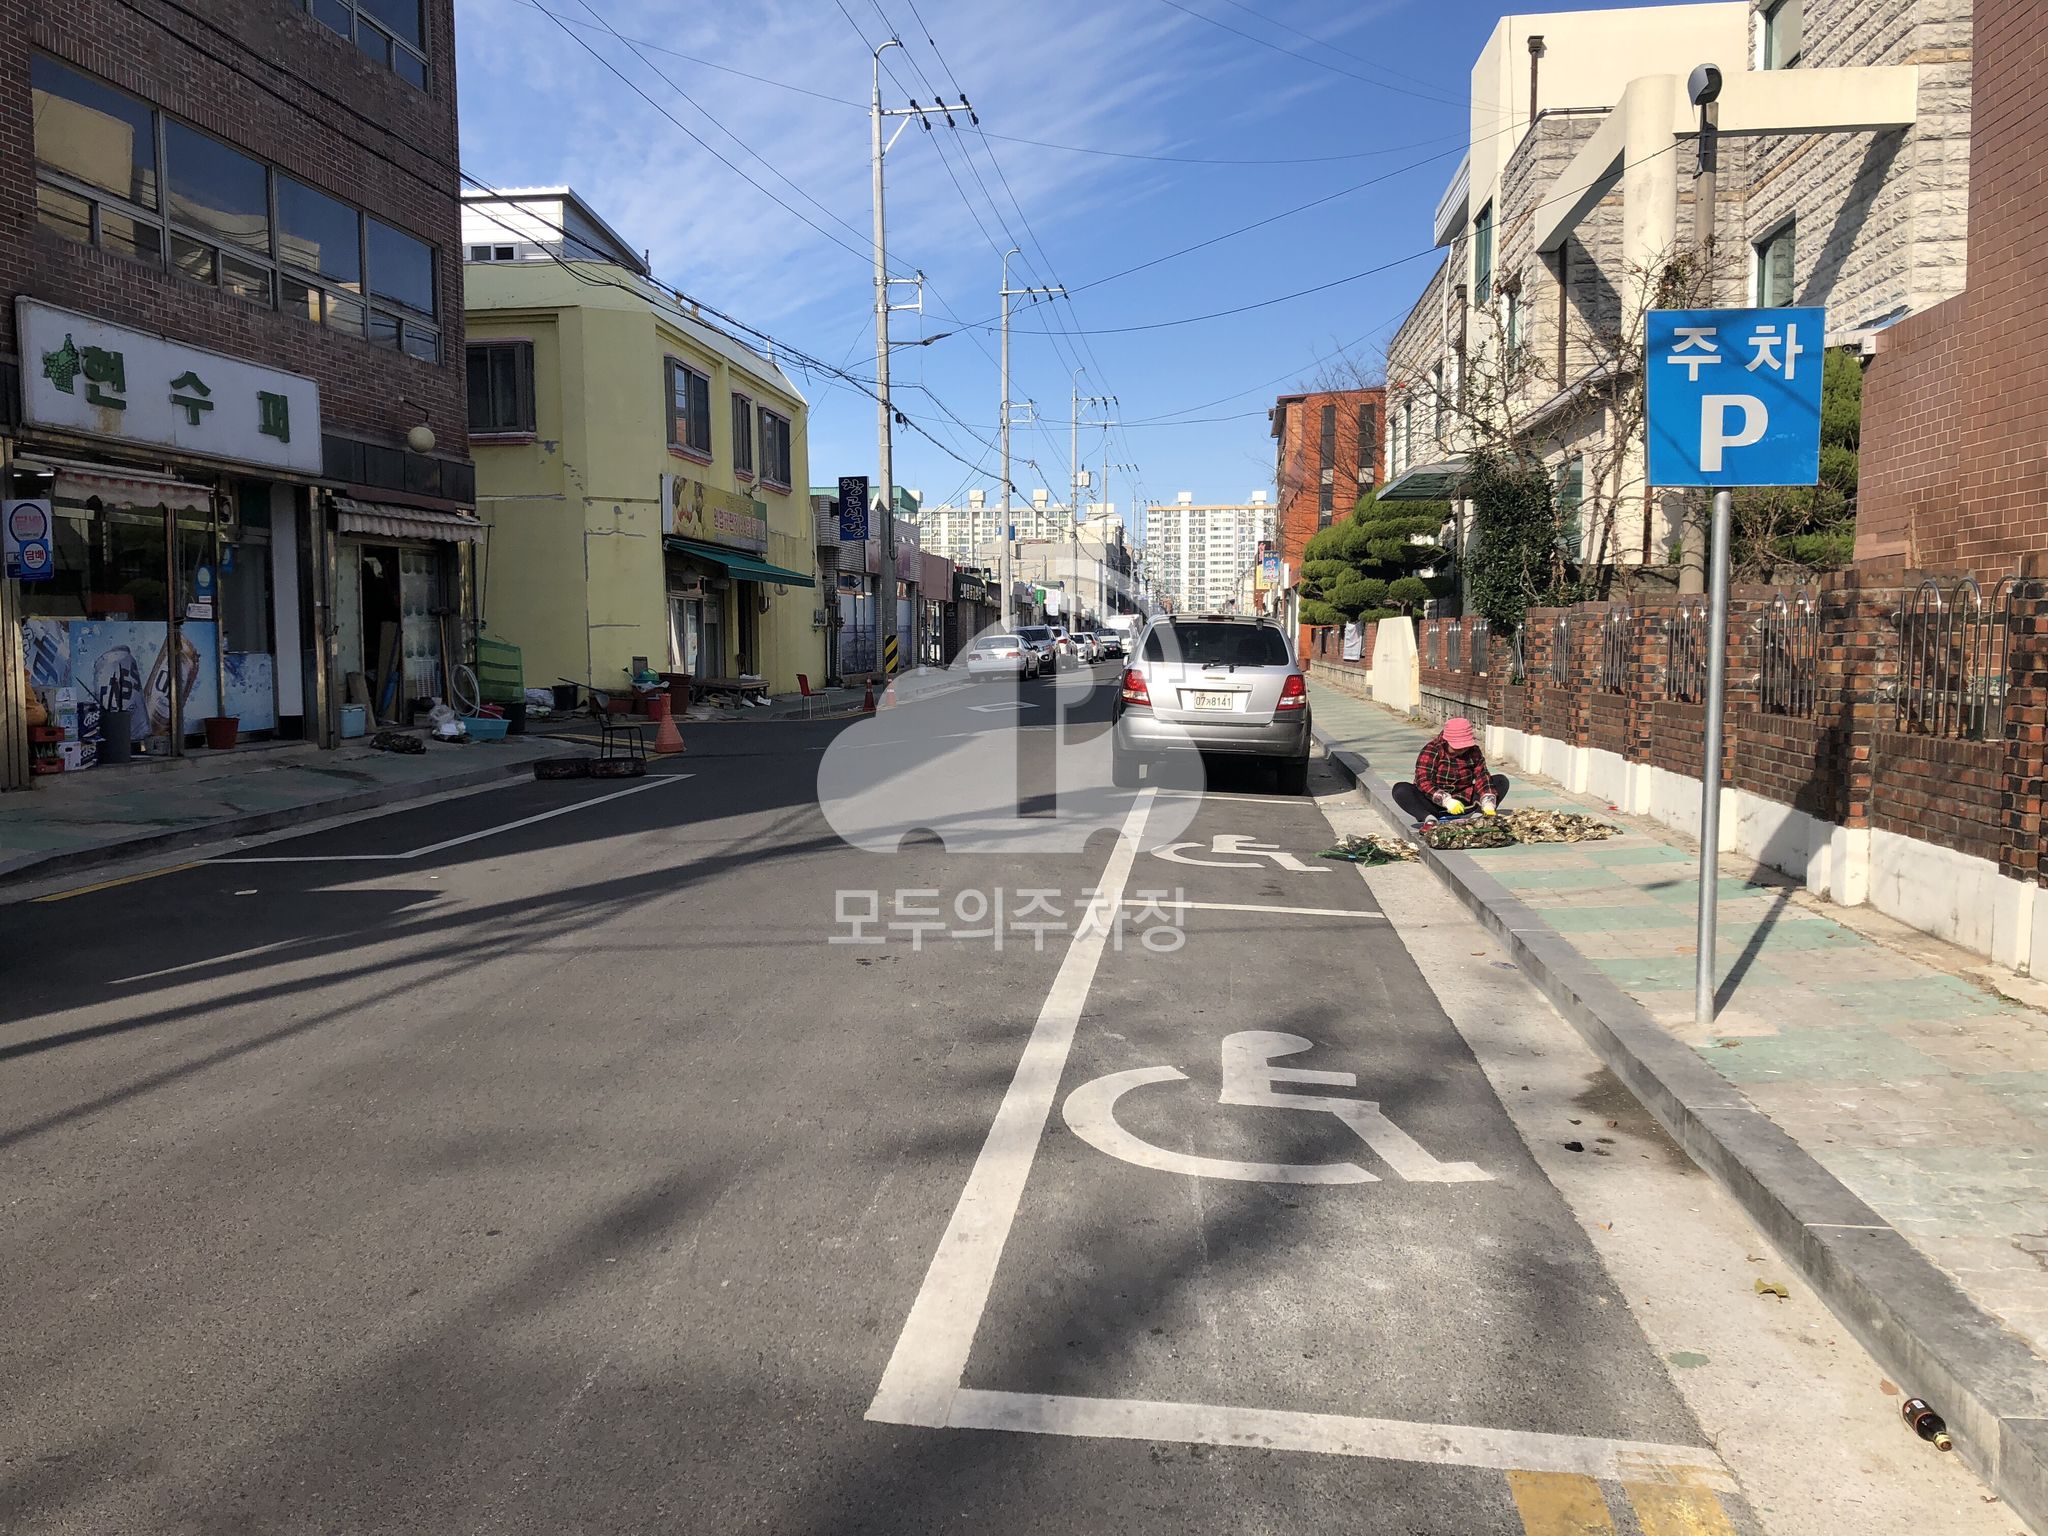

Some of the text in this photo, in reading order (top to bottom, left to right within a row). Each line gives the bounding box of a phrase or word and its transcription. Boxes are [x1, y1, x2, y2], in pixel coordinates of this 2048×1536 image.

[1699, 394, 1769, 472] P
[841, 478, 867, 538] 창고식당
[25, 549, 45, 561] 담배
